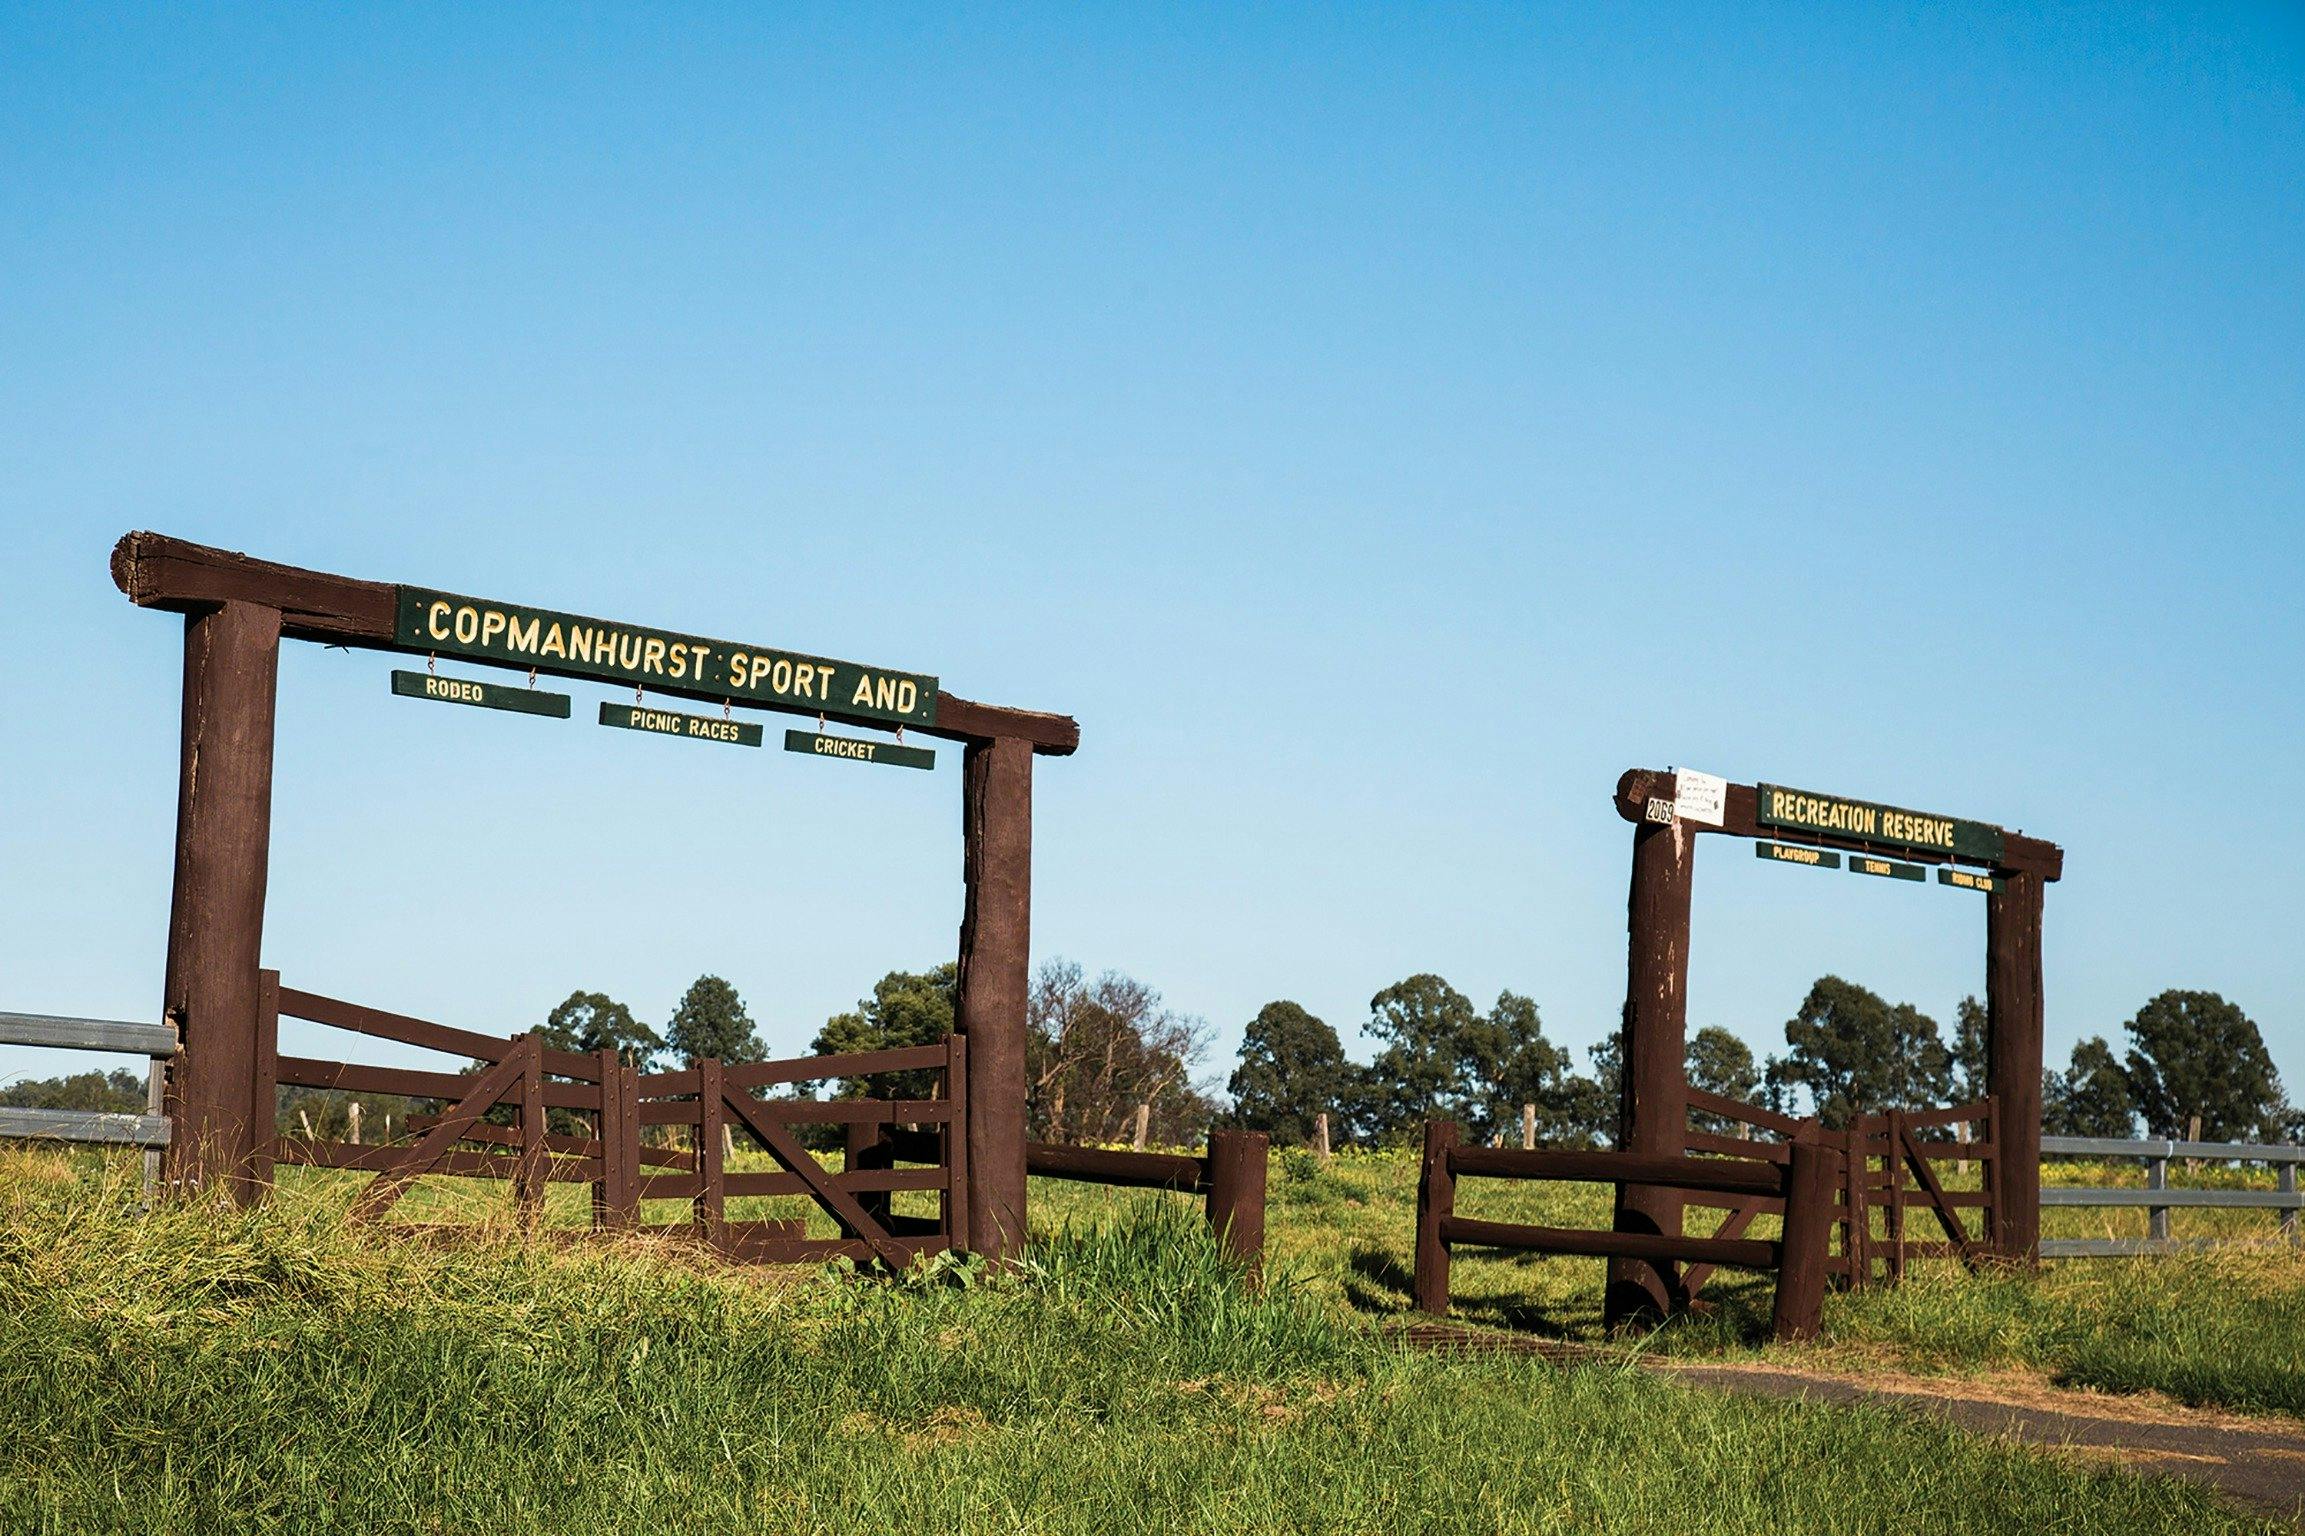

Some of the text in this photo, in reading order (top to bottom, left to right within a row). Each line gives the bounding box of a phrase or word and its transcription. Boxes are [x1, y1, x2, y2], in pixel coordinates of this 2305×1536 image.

[428, 601, 917, 714] COPMANHURST SPORT AND
[426, 677, 483, 702] RODEO
[630, 711, 739, 741] PICNIC RACES
[814, 737, 876, 759] CRICKET
[1647, 800, 1674, 822] 2069
[1773, 790, 1955, 848] RECREATION RESERVE
